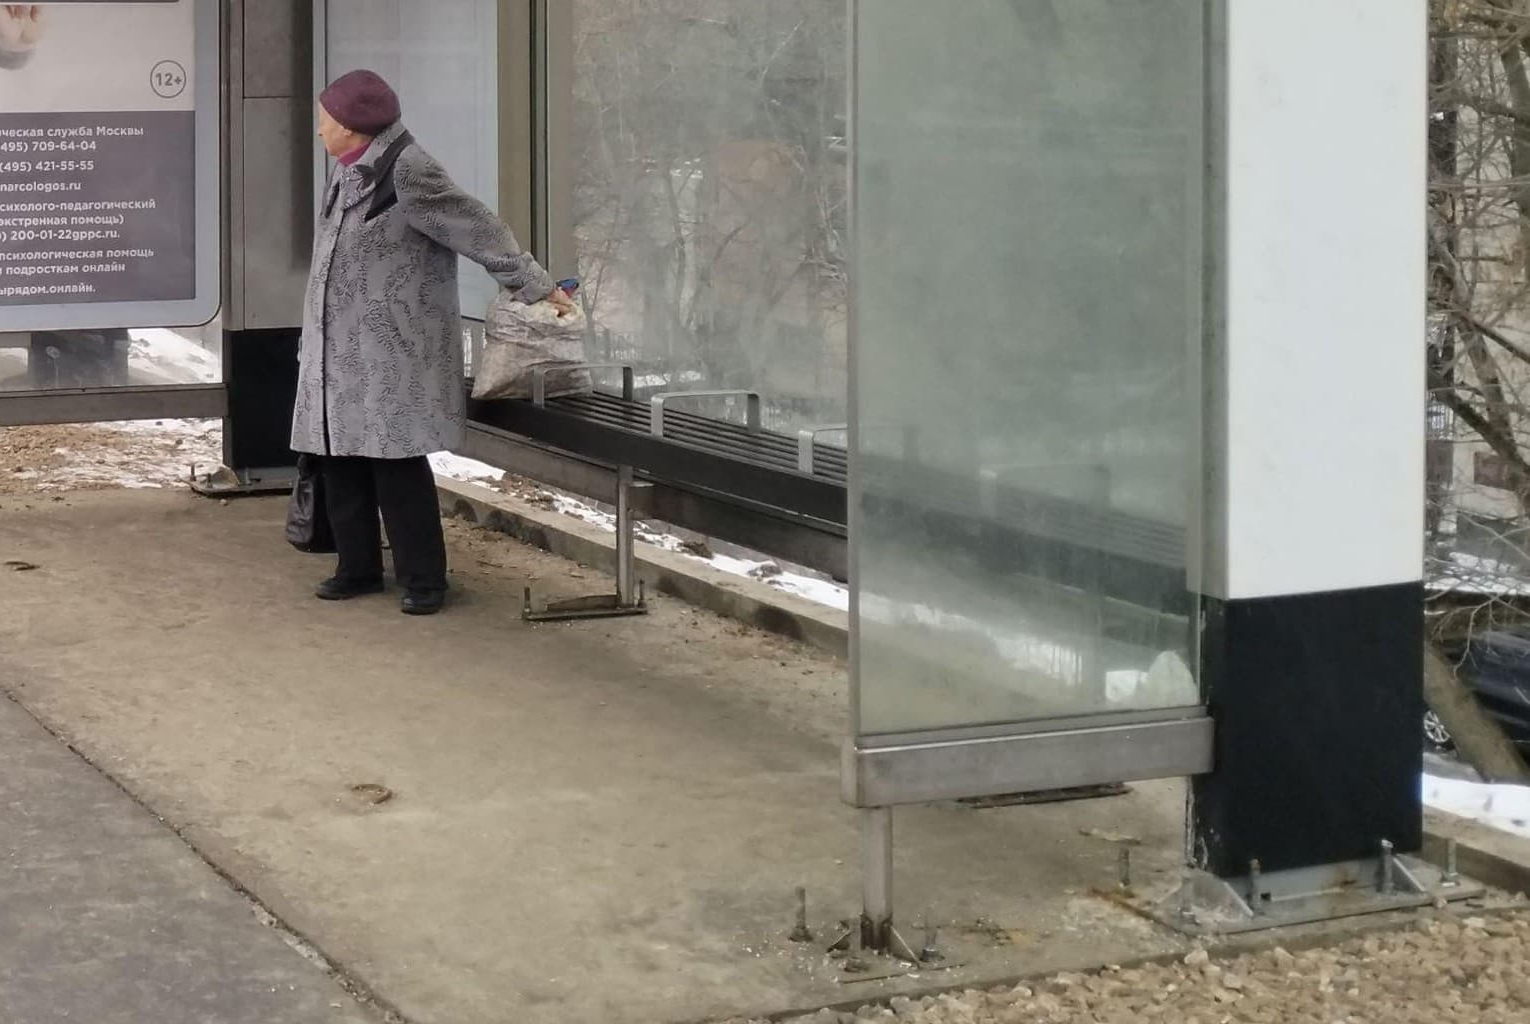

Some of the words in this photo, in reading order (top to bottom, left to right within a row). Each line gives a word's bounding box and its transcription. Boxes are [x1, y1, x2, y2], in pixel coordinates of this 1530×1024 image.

[154, 72, 183, 88] 12+
[47, 126, 93, 138] служба
[96, 125, 144, 137] Москвы
[32, 140, 97, 151] 709-64-04
[35, 161, 95, 171] 421-55-55
[0, 181, 81, 194] narcologos.ru
[70, 214, 125, 227] помощь)
[0, 249, 103, 262] психологическая
[106, 247, 154, 259] помощь
[5, 264, 79, 277] подросткам
[82, 261, 126, 273] онлайн
